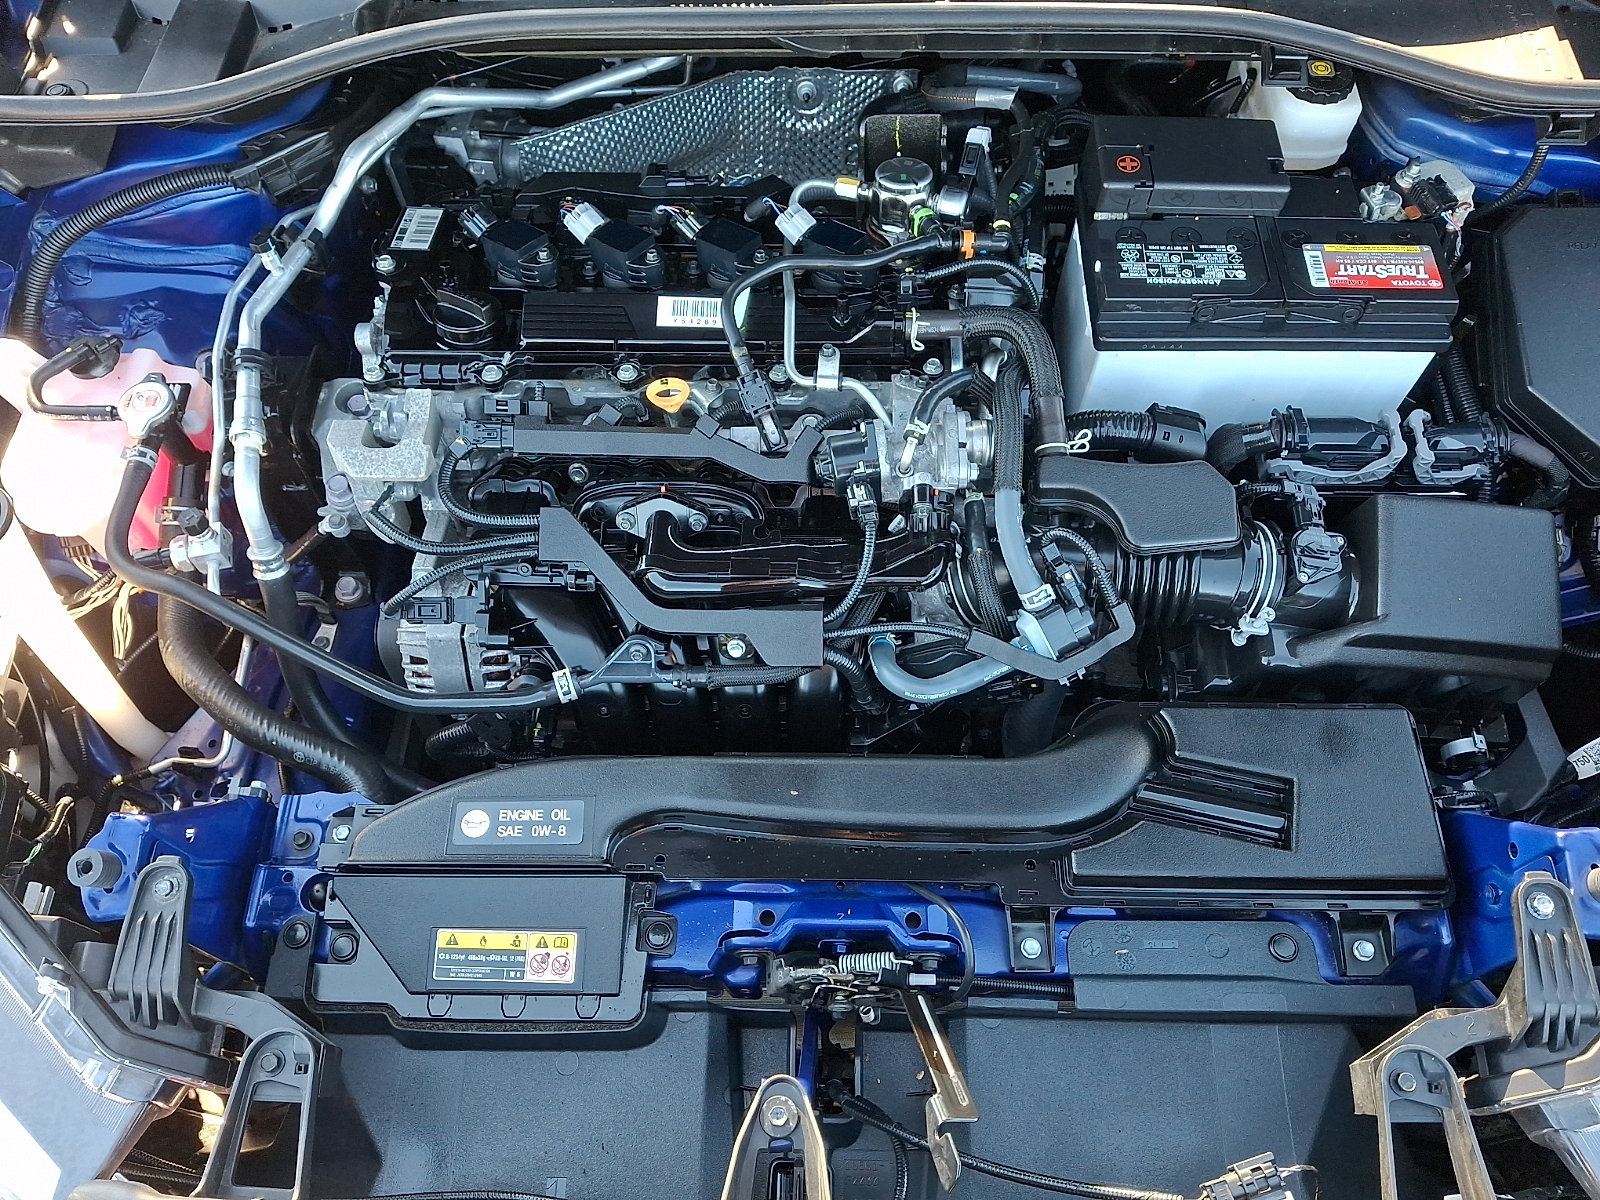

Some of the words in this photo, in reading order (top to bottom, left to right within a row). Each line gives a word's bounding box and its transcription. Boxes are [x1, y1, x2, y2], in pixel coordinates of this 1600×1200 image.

[498, 809, 544, 822] ENGINE
[550, 808, 571, 821] OIL
[496, 825, 523, 838] SAE
[531, 824, 567, 837] 0W-8
[1464, 1016, 1477, 1036] 2
